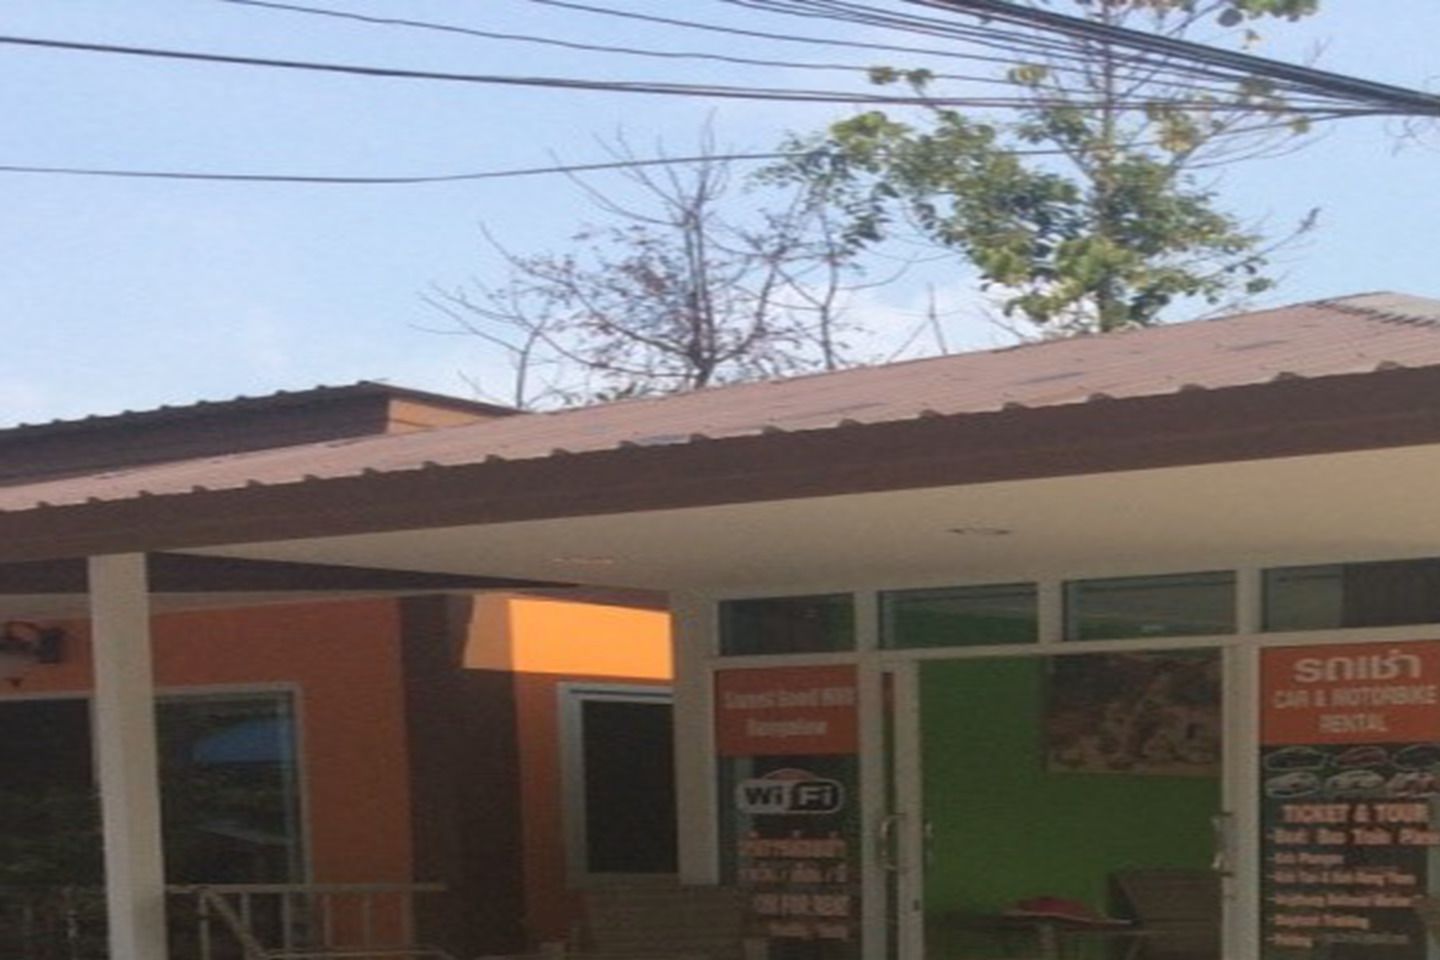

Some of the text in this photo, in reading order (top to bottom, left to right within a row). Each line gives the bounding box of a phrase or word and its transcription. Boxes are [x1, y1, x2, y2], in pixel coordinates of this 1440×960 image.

[1274, 689, 1308, 709] CAR
[1330, 685, 1438, 707] MOTORBIKE
[1317, 713, 1390, 733] RENTAL
[1281, 804, 1348, 824] TICKET
[1373, 803, 1429, 823] TOUR
